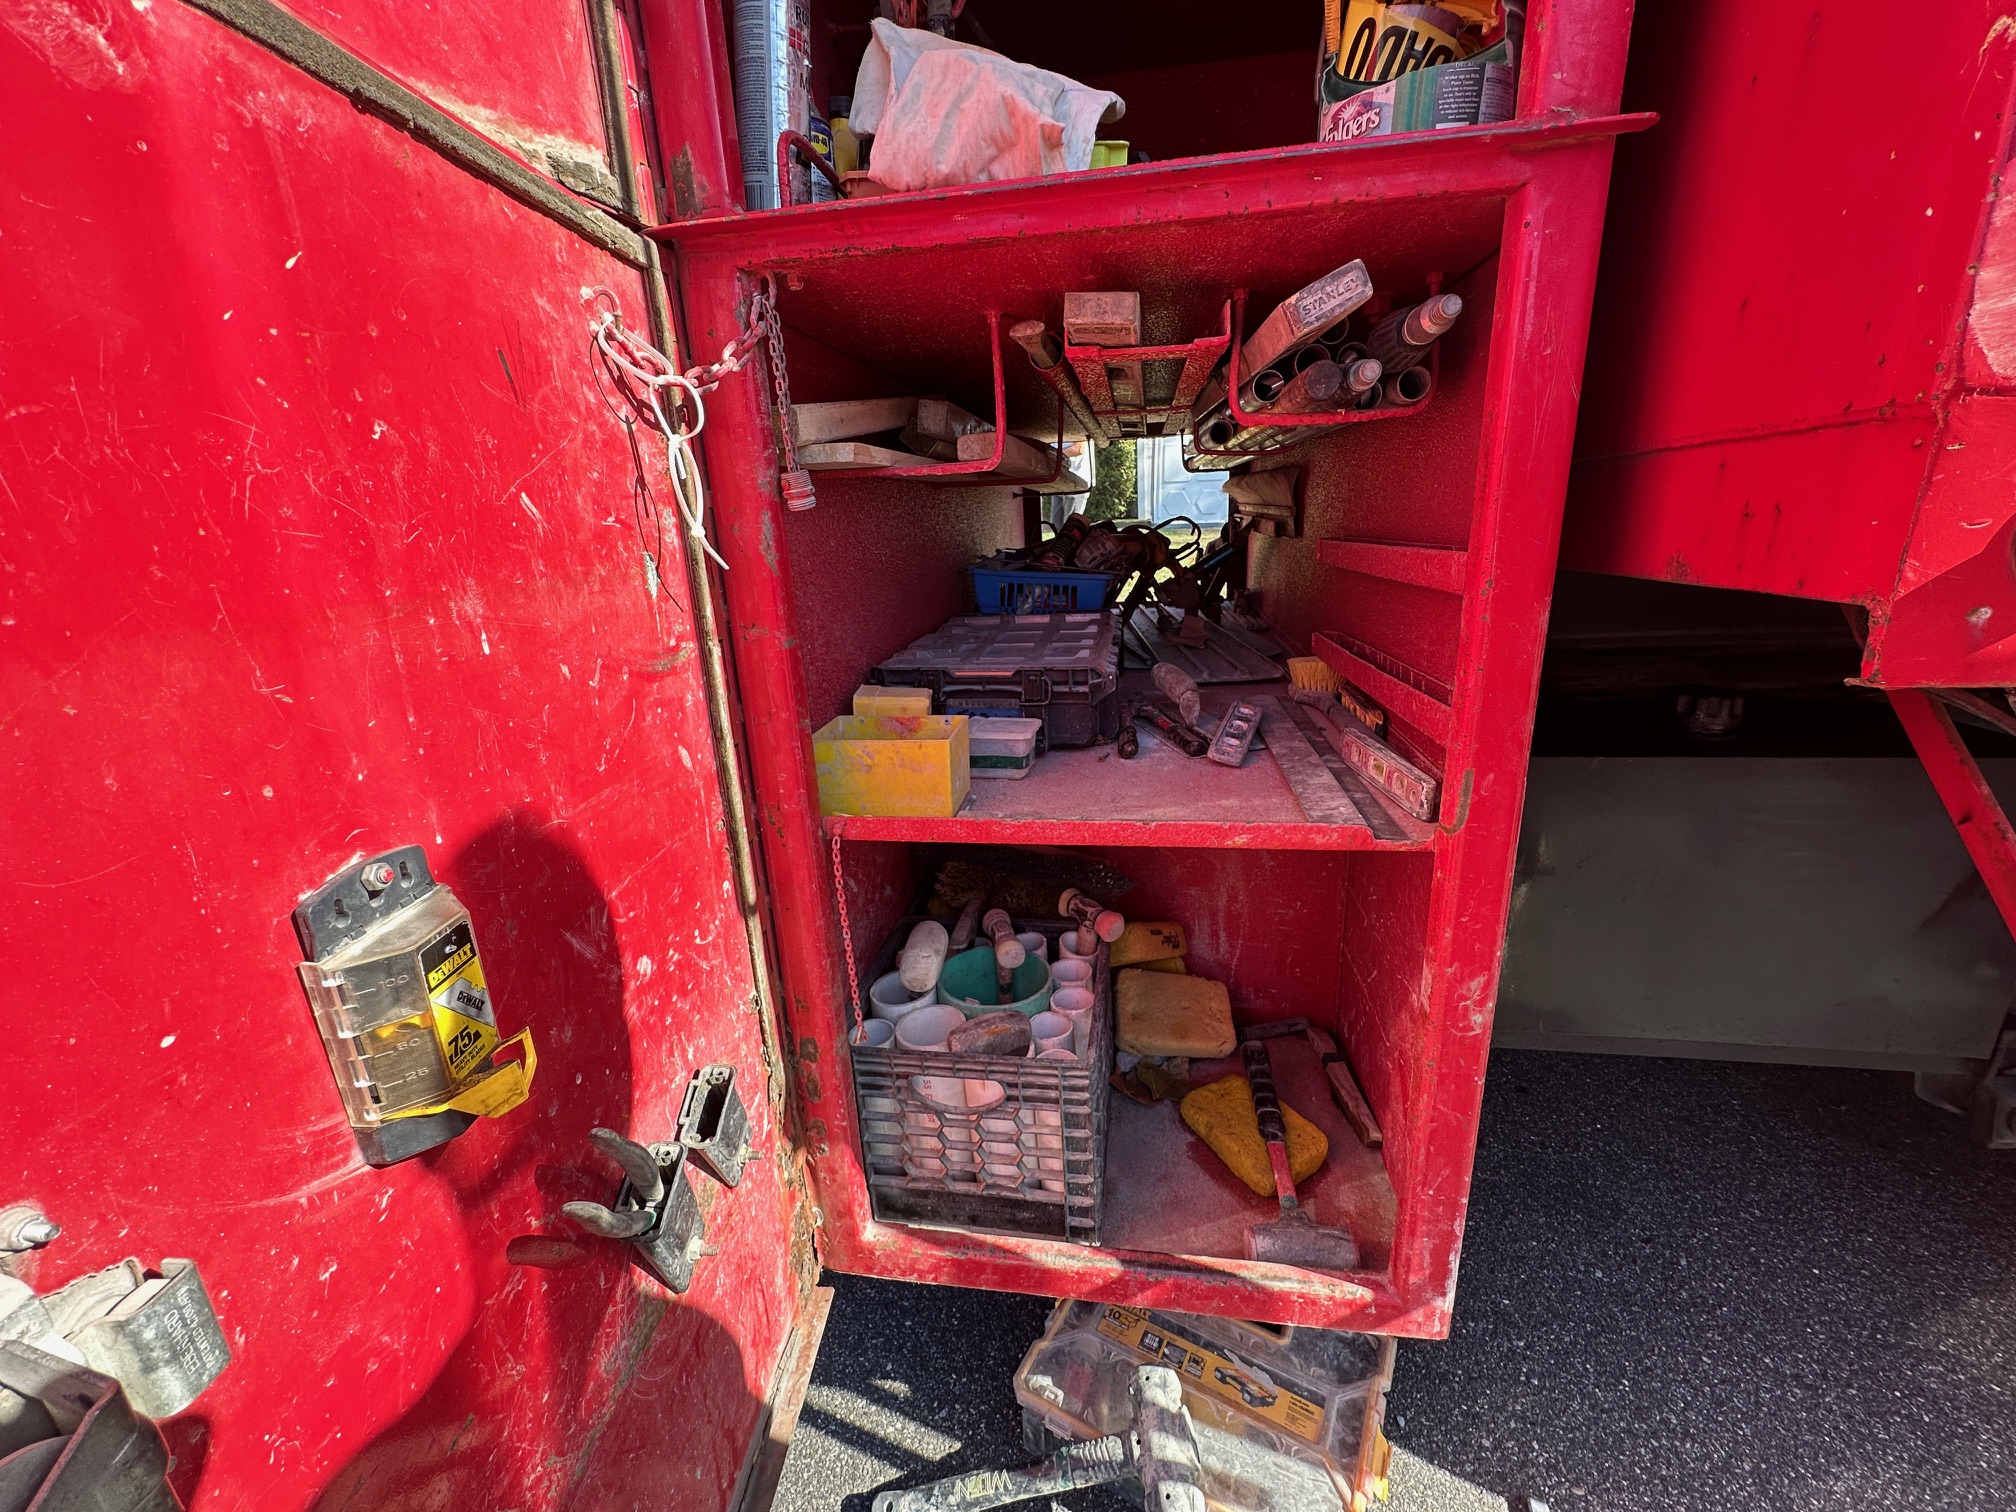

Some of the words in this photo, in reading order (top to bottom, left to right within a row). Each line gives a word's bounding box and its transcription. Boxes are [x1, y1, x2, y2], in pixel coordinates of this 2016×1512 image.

[1302, 275, 1359, 316] STANLEY
[379, 974, 409, 990] 100
[397, 1038, 420, 1050] 50
[448, 1025, 474, 1061] 75
[406, 1067, 430, 1081] 25
[1108, 1308, 1121, 1320] 10
[164, 1309, 200, 1375] EBERHARD
[193, 1326, 216, 1369] PATENTED
